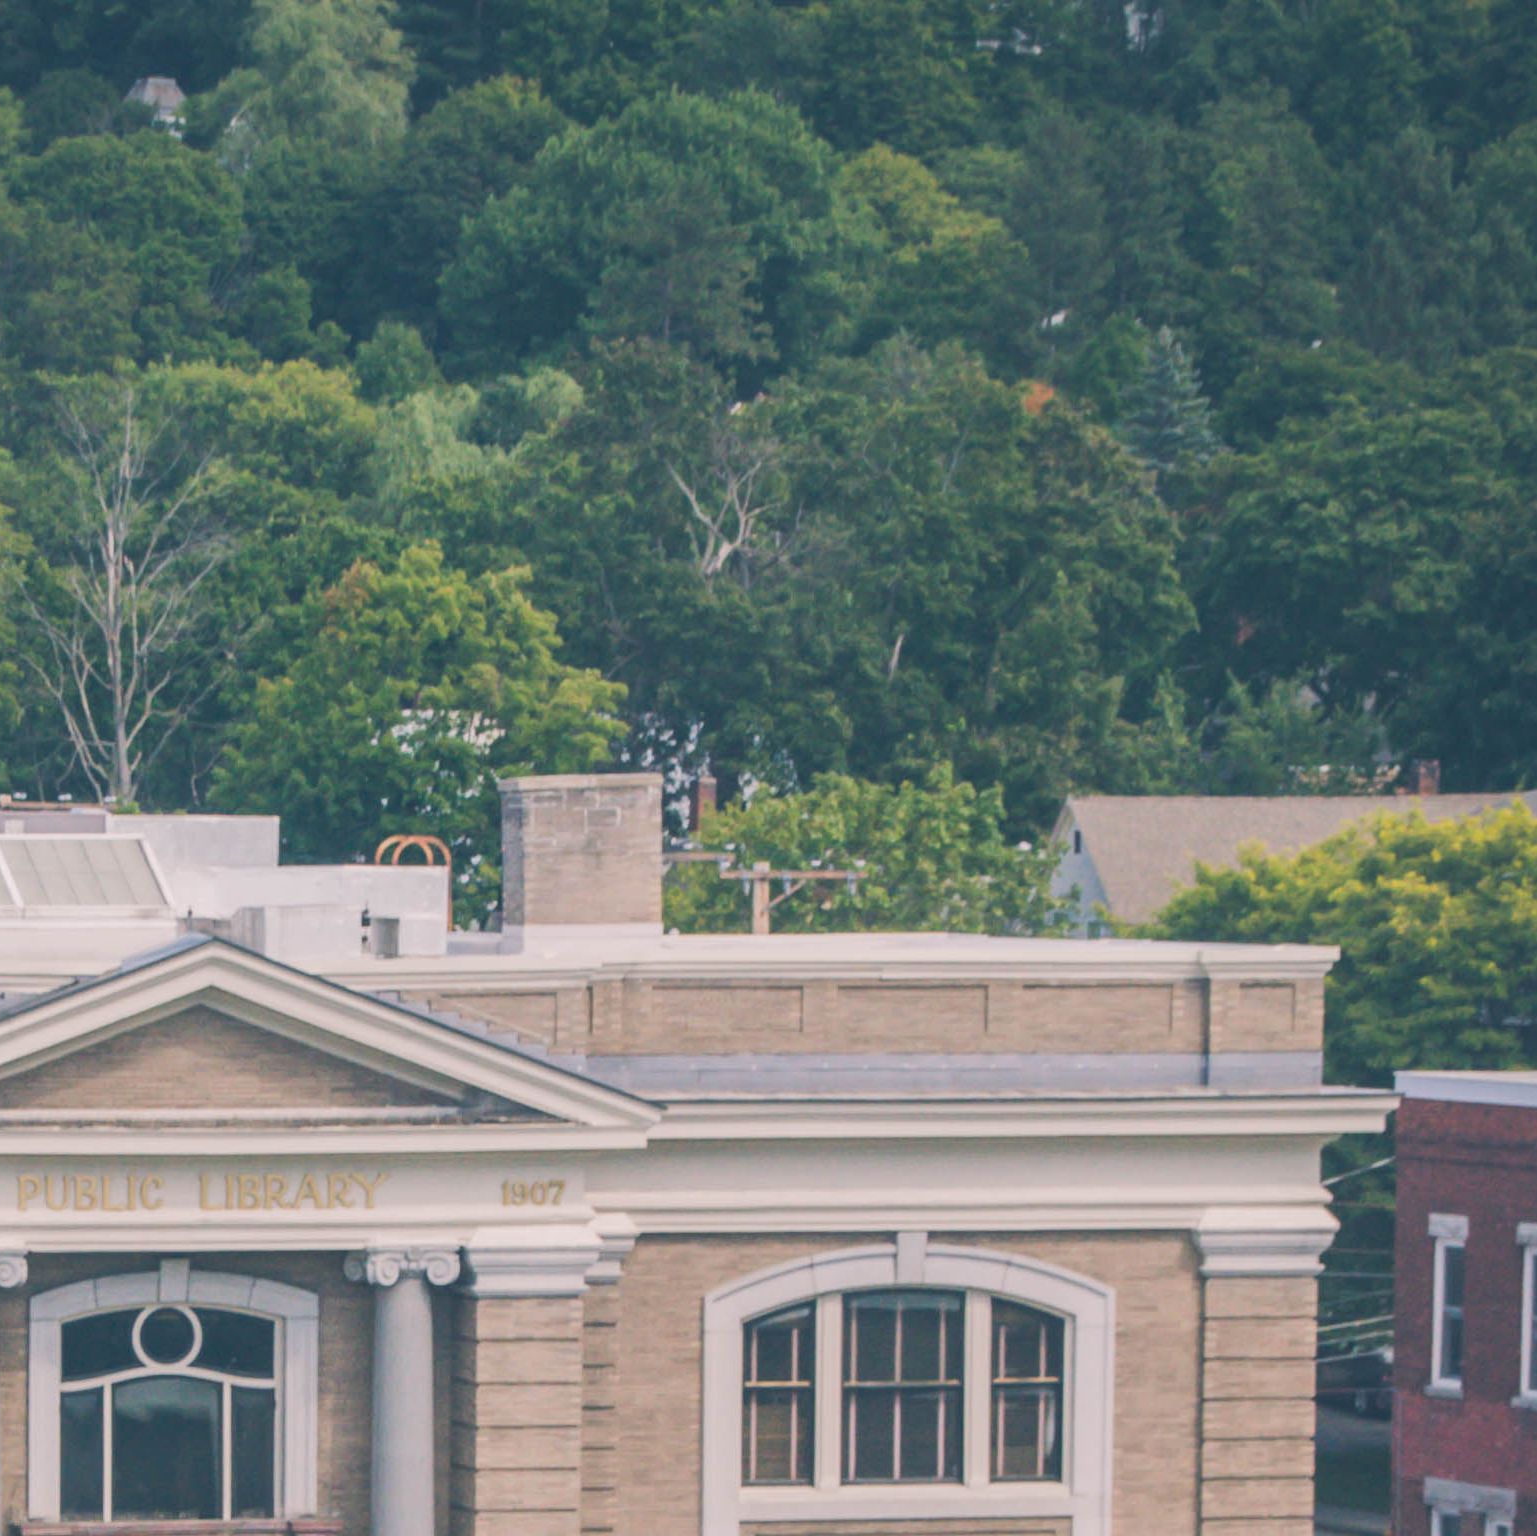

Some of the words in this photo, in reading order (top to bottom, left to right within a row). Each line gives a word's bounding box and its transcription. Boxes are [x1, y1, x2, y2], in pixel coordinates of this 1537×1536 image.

[16, 1174, 163, 1211] PUBLIC
[198, 1172, 390, 1210] LIBRARY
[501, 1179, 565, 1206] 1907
